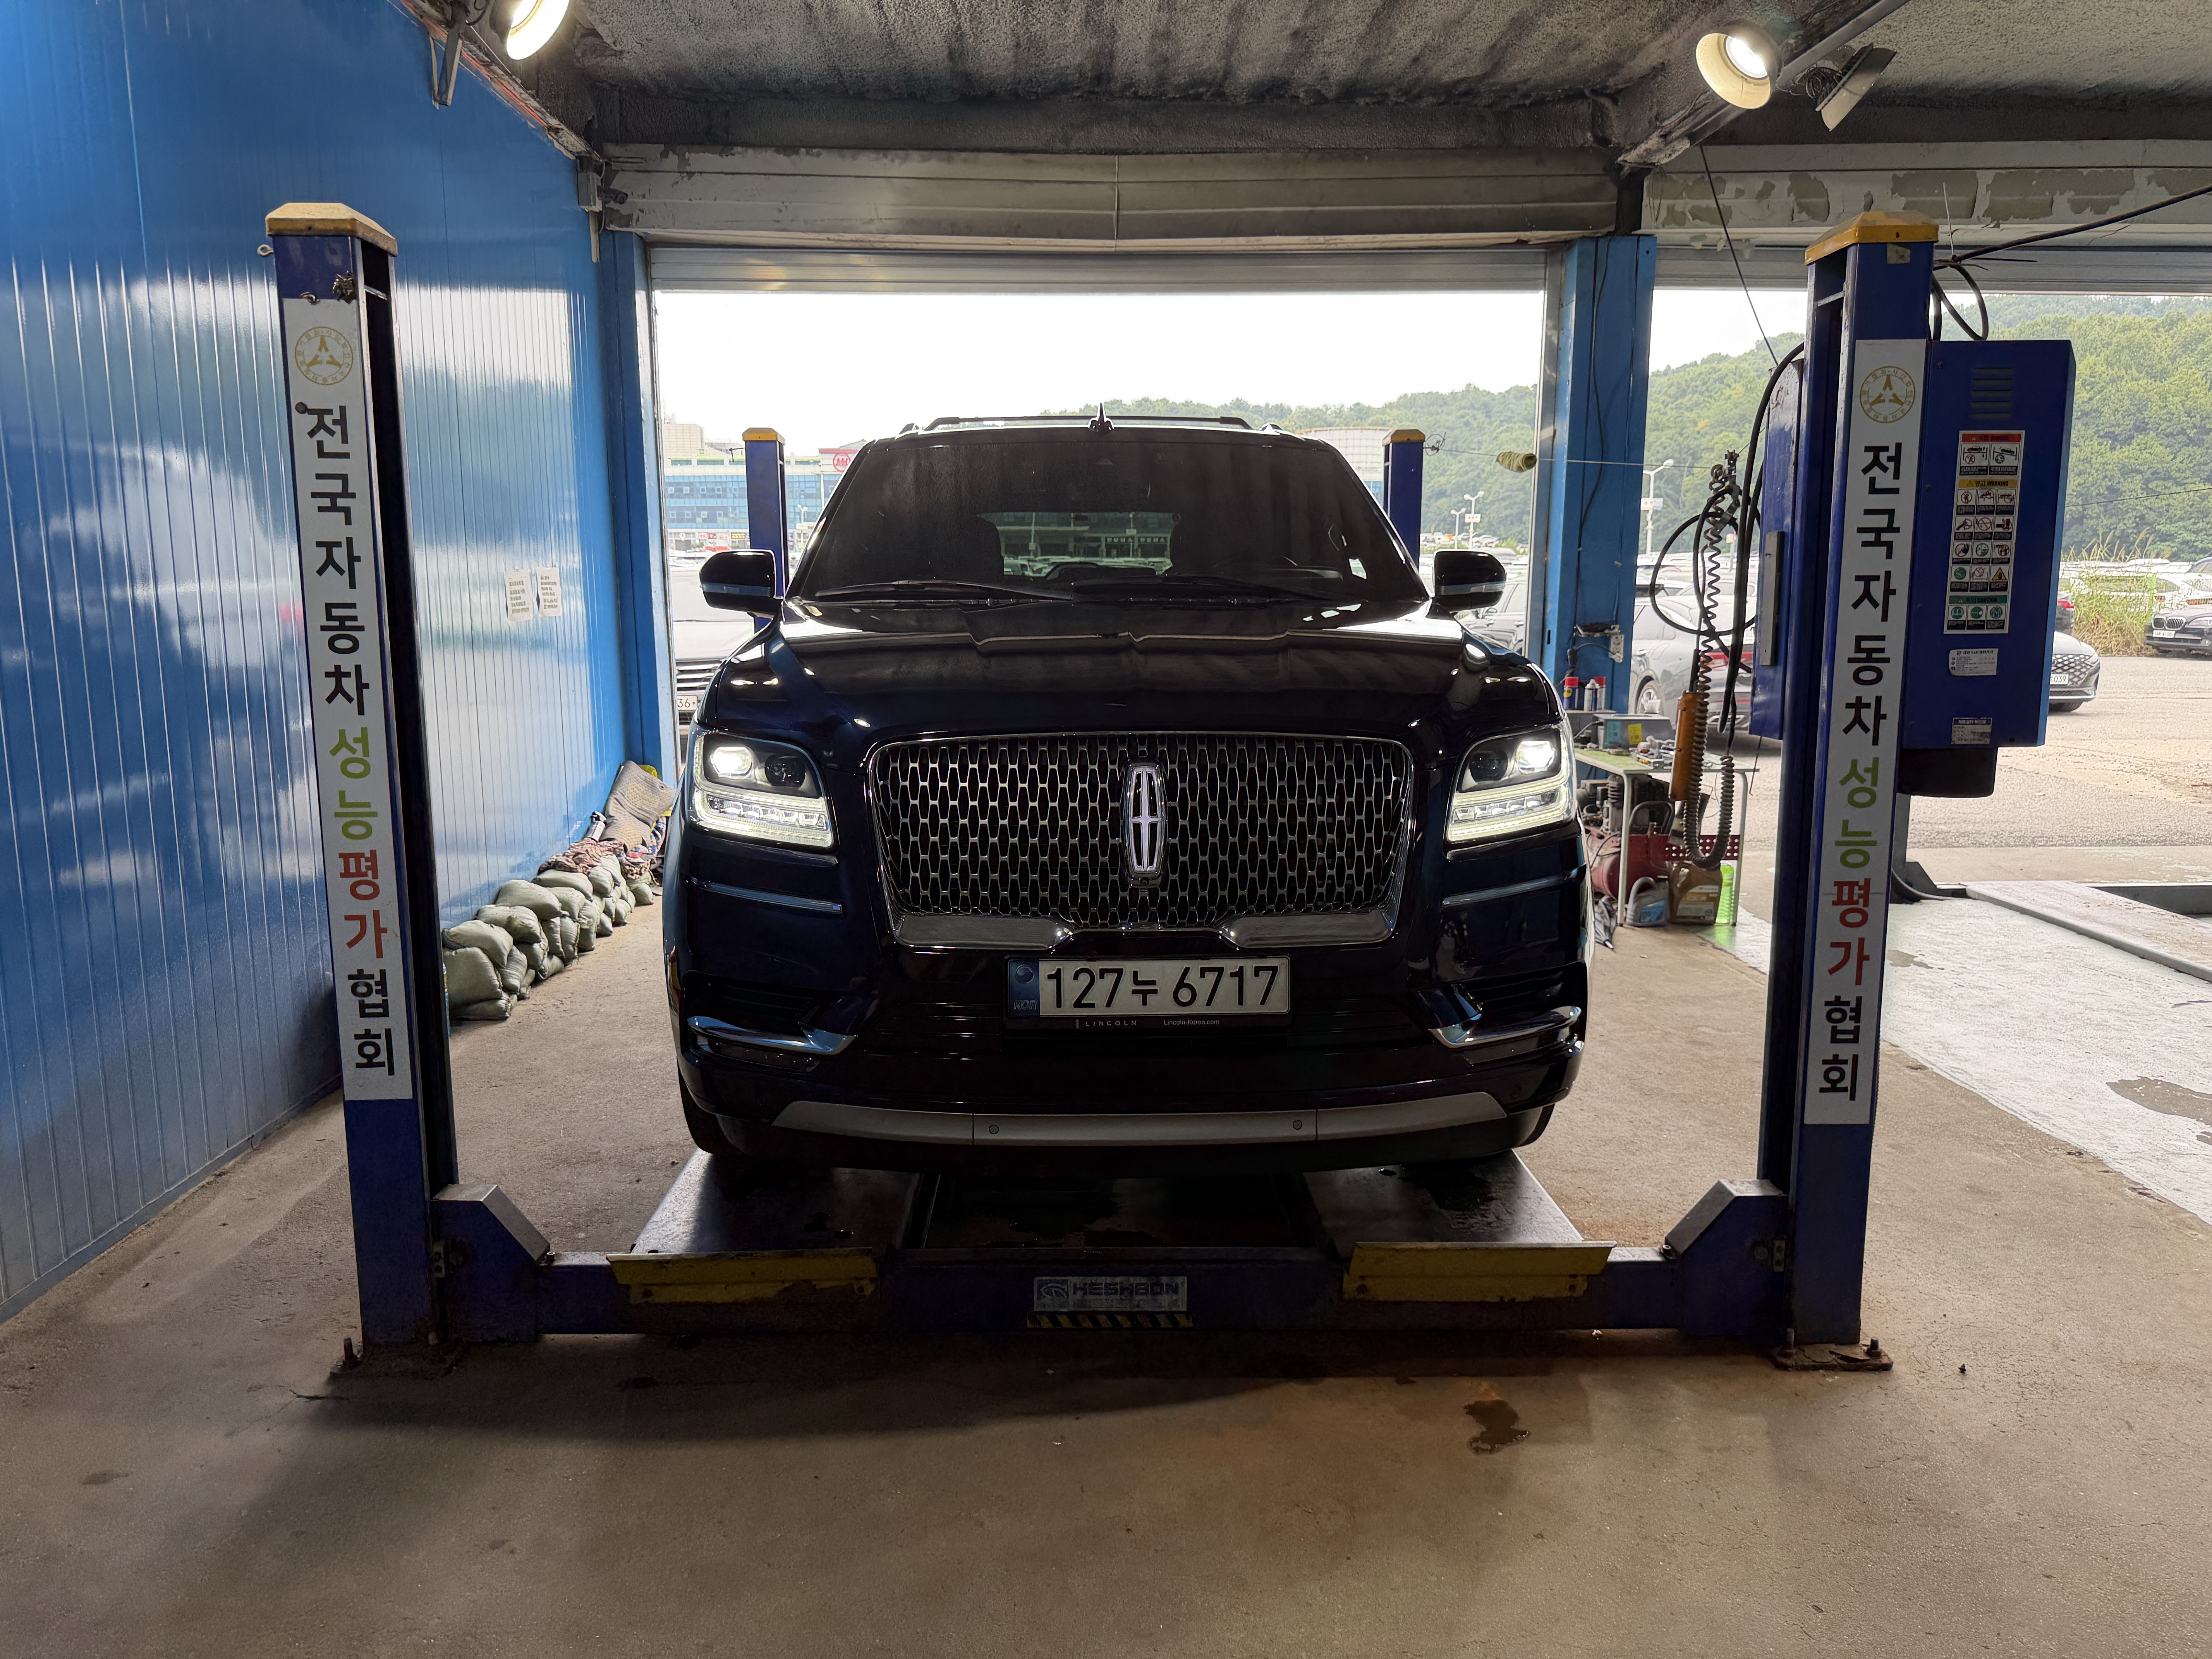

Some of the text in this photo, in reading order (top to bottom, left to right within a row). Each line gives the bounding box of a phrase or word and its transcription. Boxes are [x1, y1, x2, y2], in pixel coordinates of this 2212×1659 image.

[306, 405, 395, 1076] 전국자동차성능평가협회
[1819, 442, 1903, 1101] 전국자동차성능평가협회
[1013, 1000, 1037, 1010] KOR
[1048, 966, 1279, 1008] 127누 6717
